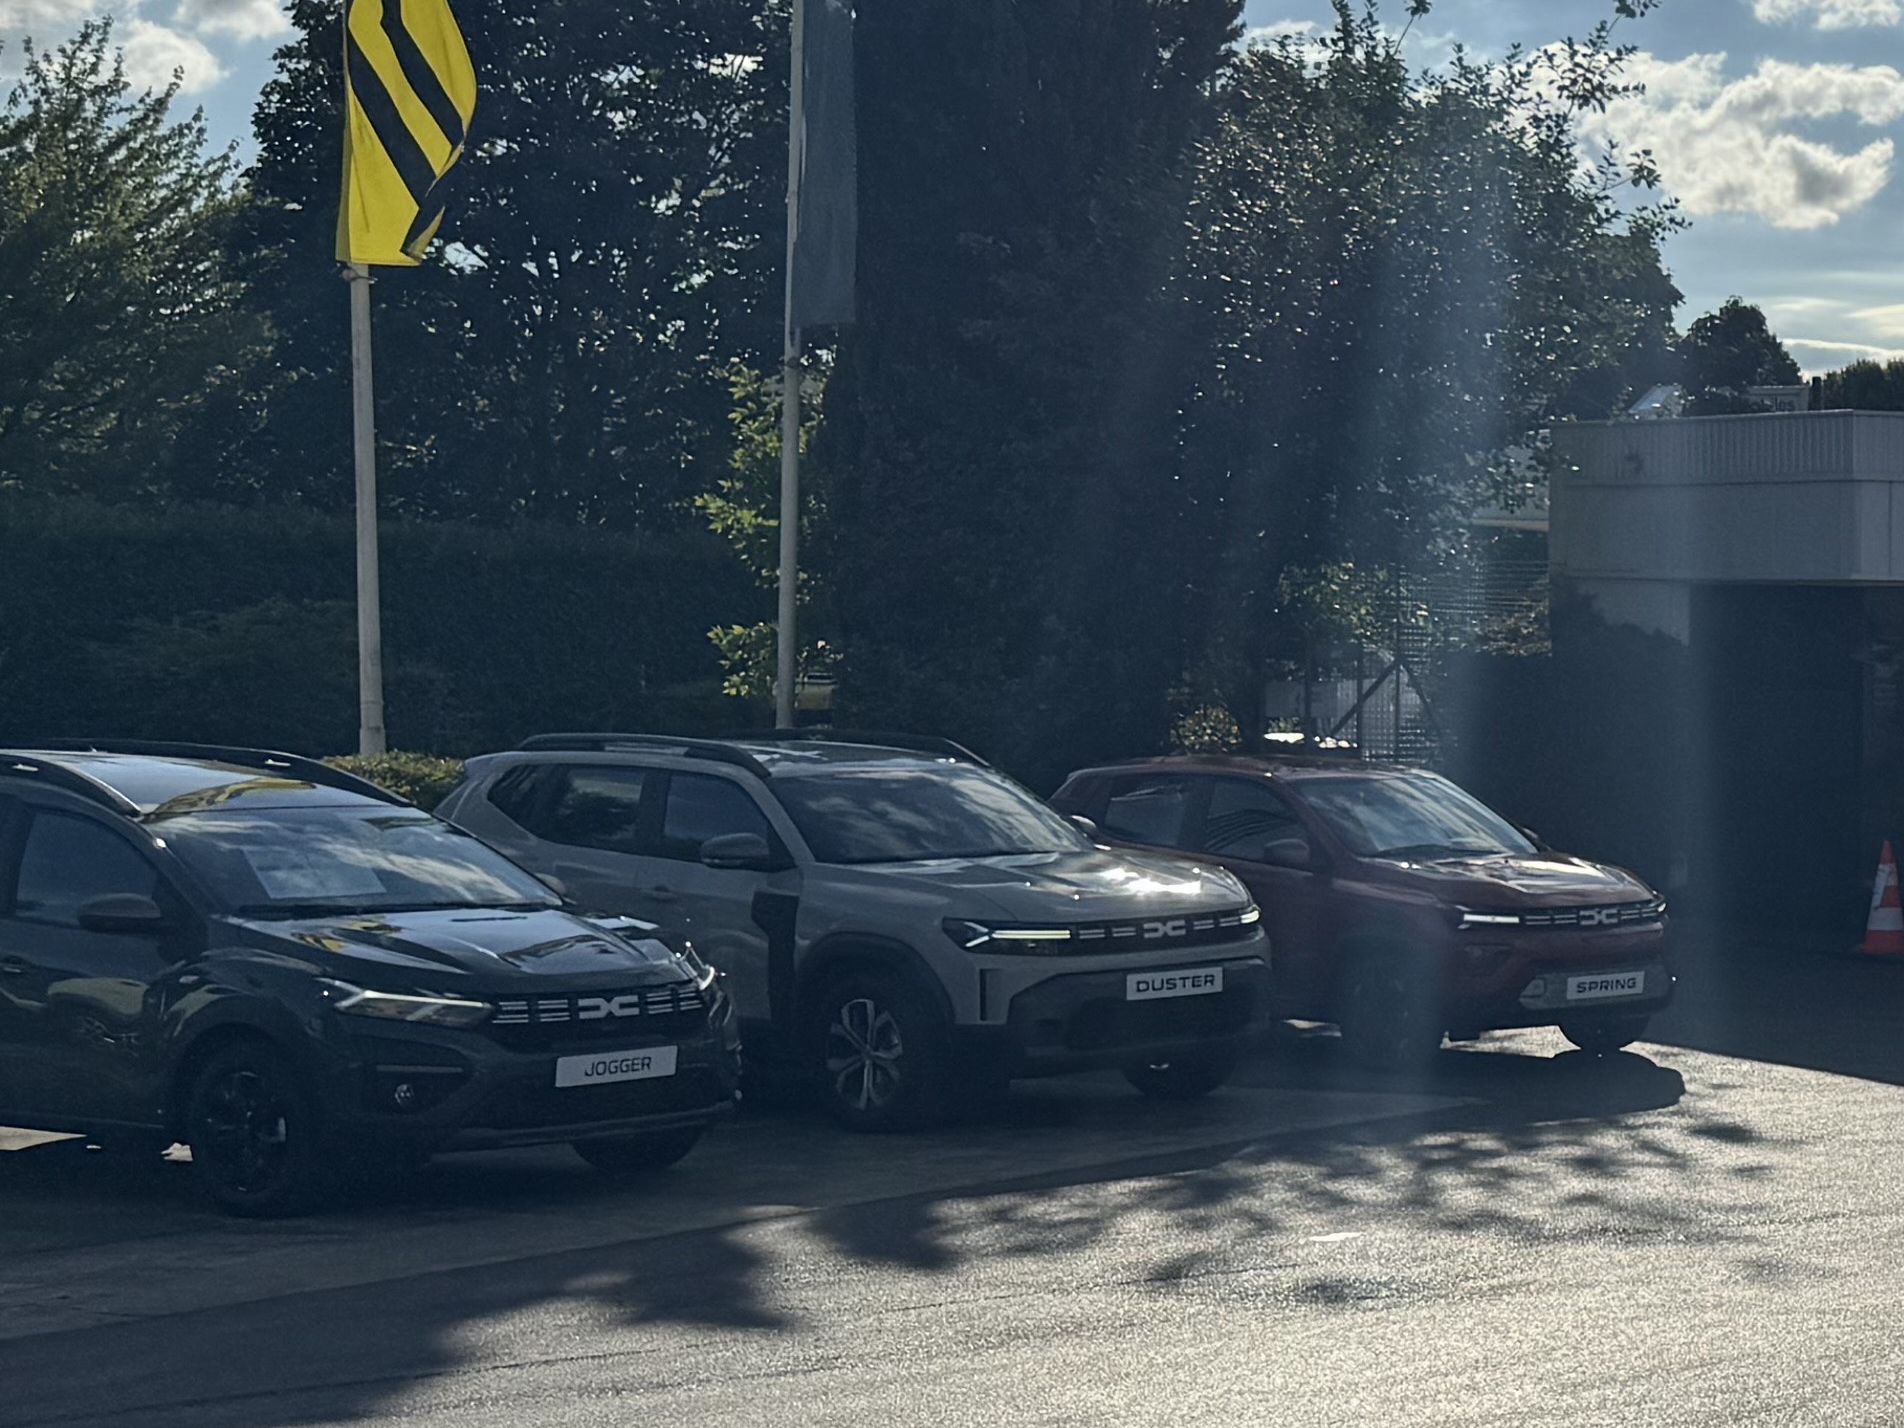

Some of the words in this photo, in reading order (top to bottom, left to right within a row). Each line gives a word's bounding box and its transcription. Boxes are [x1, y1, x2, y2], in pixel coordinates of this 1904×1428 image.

[1136, 974, 1216, 993] DUSTER
[1576, 977, 1637, 994] SPRING
[584, 1056, 652, 1077] JOGGER
